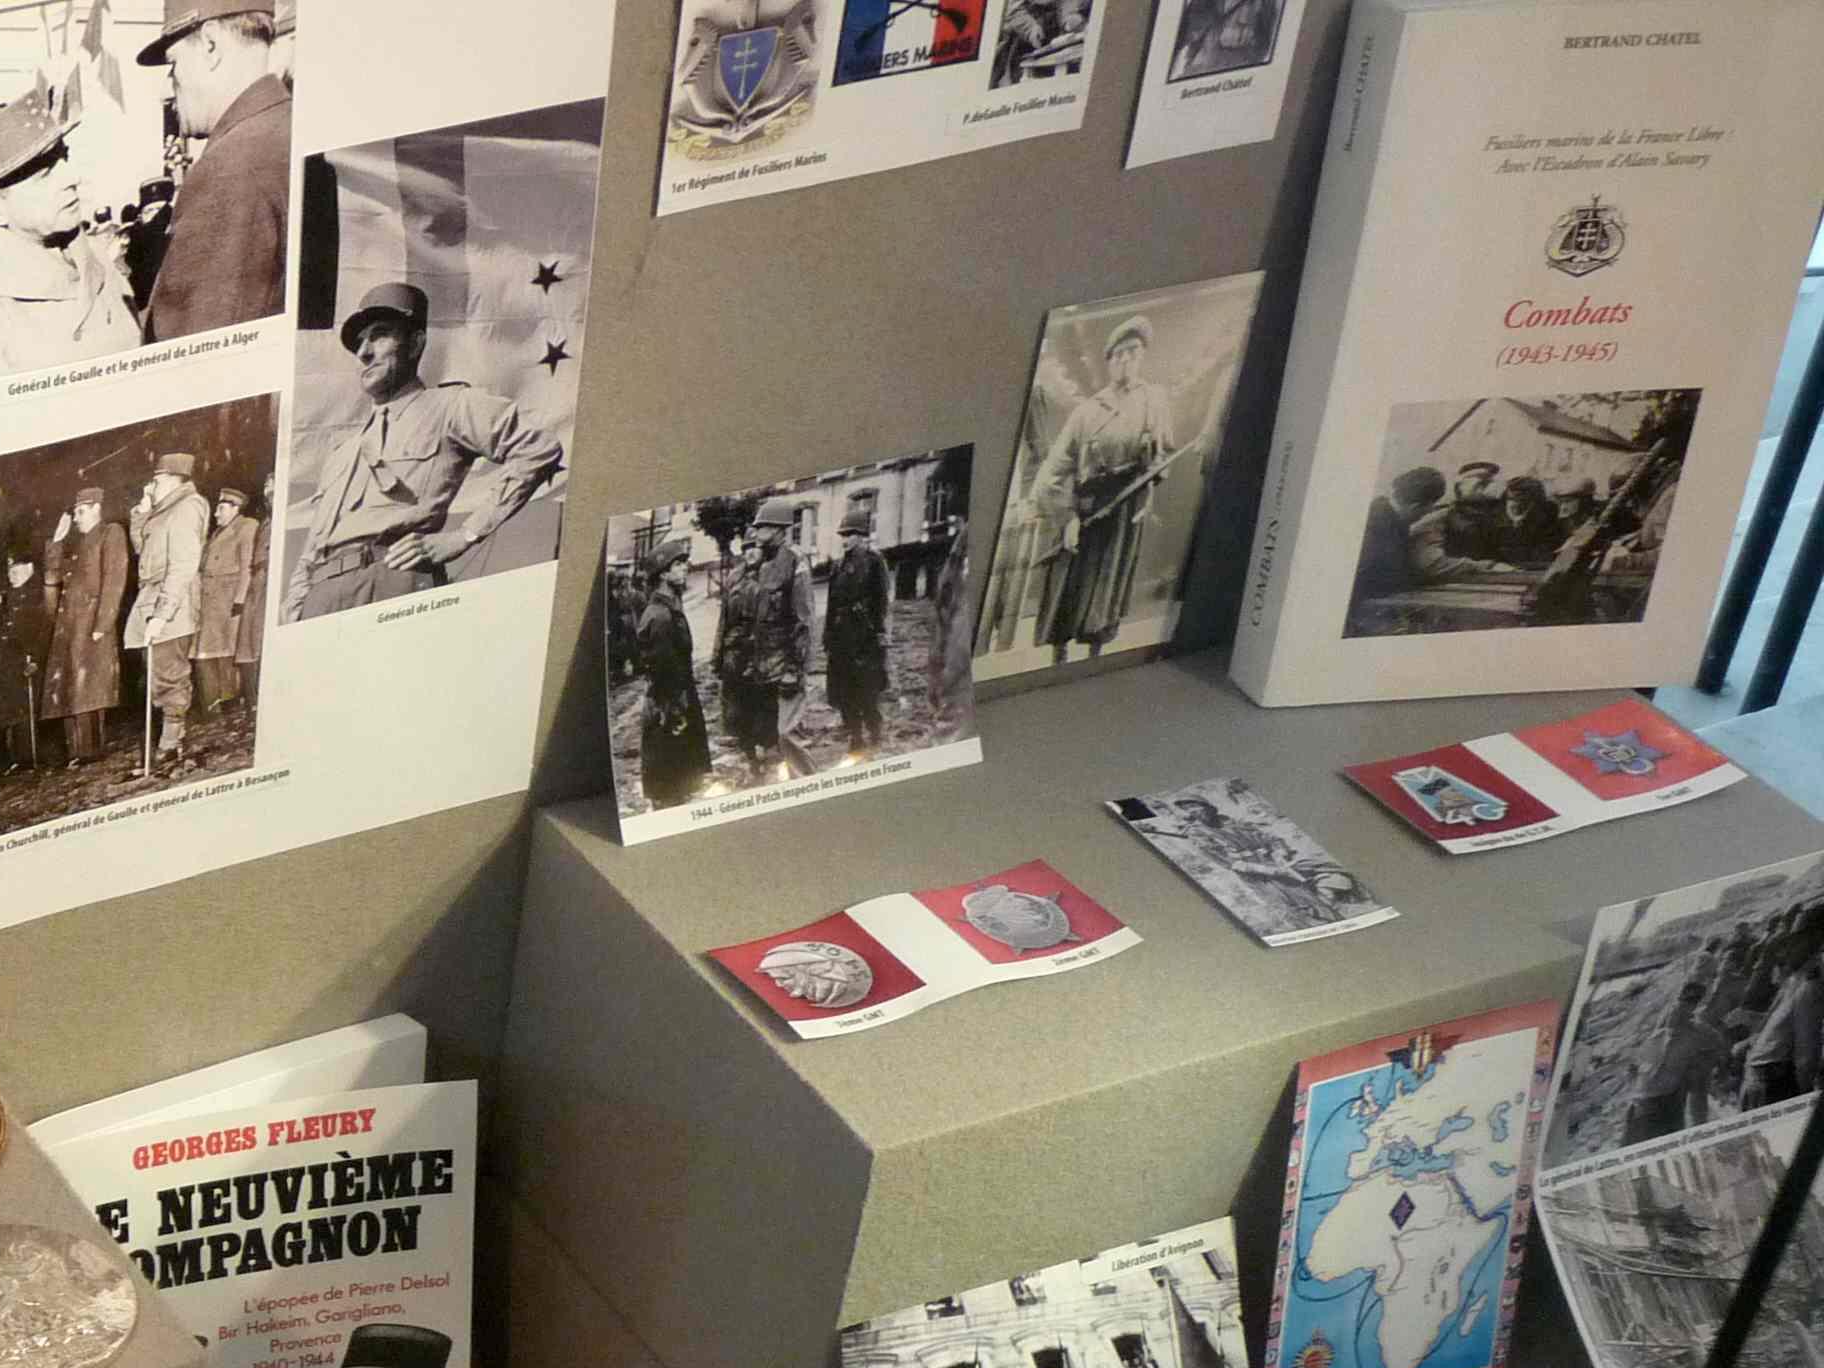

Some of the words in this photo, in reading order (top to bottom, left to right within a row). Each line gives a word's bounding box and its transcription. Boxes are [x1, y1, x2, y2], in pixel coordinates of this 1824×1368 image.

[1563, 34, 1643, 50] BERTRAND
[1645, 31, 1702, 48] CHATEL
[1597, 130, 1616, 147] de
[1636, 127, 1685, 146] France
[737, 167, 751, 180] de
[1504, 295, 1634, 329] Combats
[8, 376, 51, 396] Général
[53, 374, 67, 387] de
[69, 365, 103, 383] Gaulle
[105, 363, 117, 375] et
[119, 359, 128, 372] le
[131, 350, 172, 372] général
[173, 346, 187, 360] de
[189, 339, 221, 357] Lattre
[223, 336, 230, 348] à
[231, 329, 259, 347] Alger
[1495, 341, 1619, 369] (1943-1945)
[416, 602, 428, 614] de
[430, 596, 461, 611] Lattre
[719, 795, 755, 815] Général
[821, 776, 834, 790] les
[834, 770, 869, 791] troupes
[870, 768, 882, 779] en
[882, 759, 913, 776] France
[53, 816, 92, 839] général
[93, 814, 106, 827] de
[107, 805, 138, 822] Gaulle
[140, 803, 151, 815] et
[152, 790, 190, 813] général
[191, 787, 205, 800] de
[205, 780, 236, 798] Lattre
[237, 777, 244, 790] à
[132, 1125, 257, 1171] GEORGES
[267, 1107, 376, 1148] FLEURY
[156, 1148, 454, 1237] NEUVIÈME
[131, 1205, 422, 1290] OMPAGNON
[1111, 1249, 1158, 1273] Libération
[1159, 1236, 1205, 1263] d'Avignon
[244, 1286, 319, 1315] L'épopée
[323, 1285, 344, 1301] de
[348, 1278, 396, 1298] Pierre
[401, 1272, 451, 1291] Delsol
[270, 1332, 342, 1353] Provence
